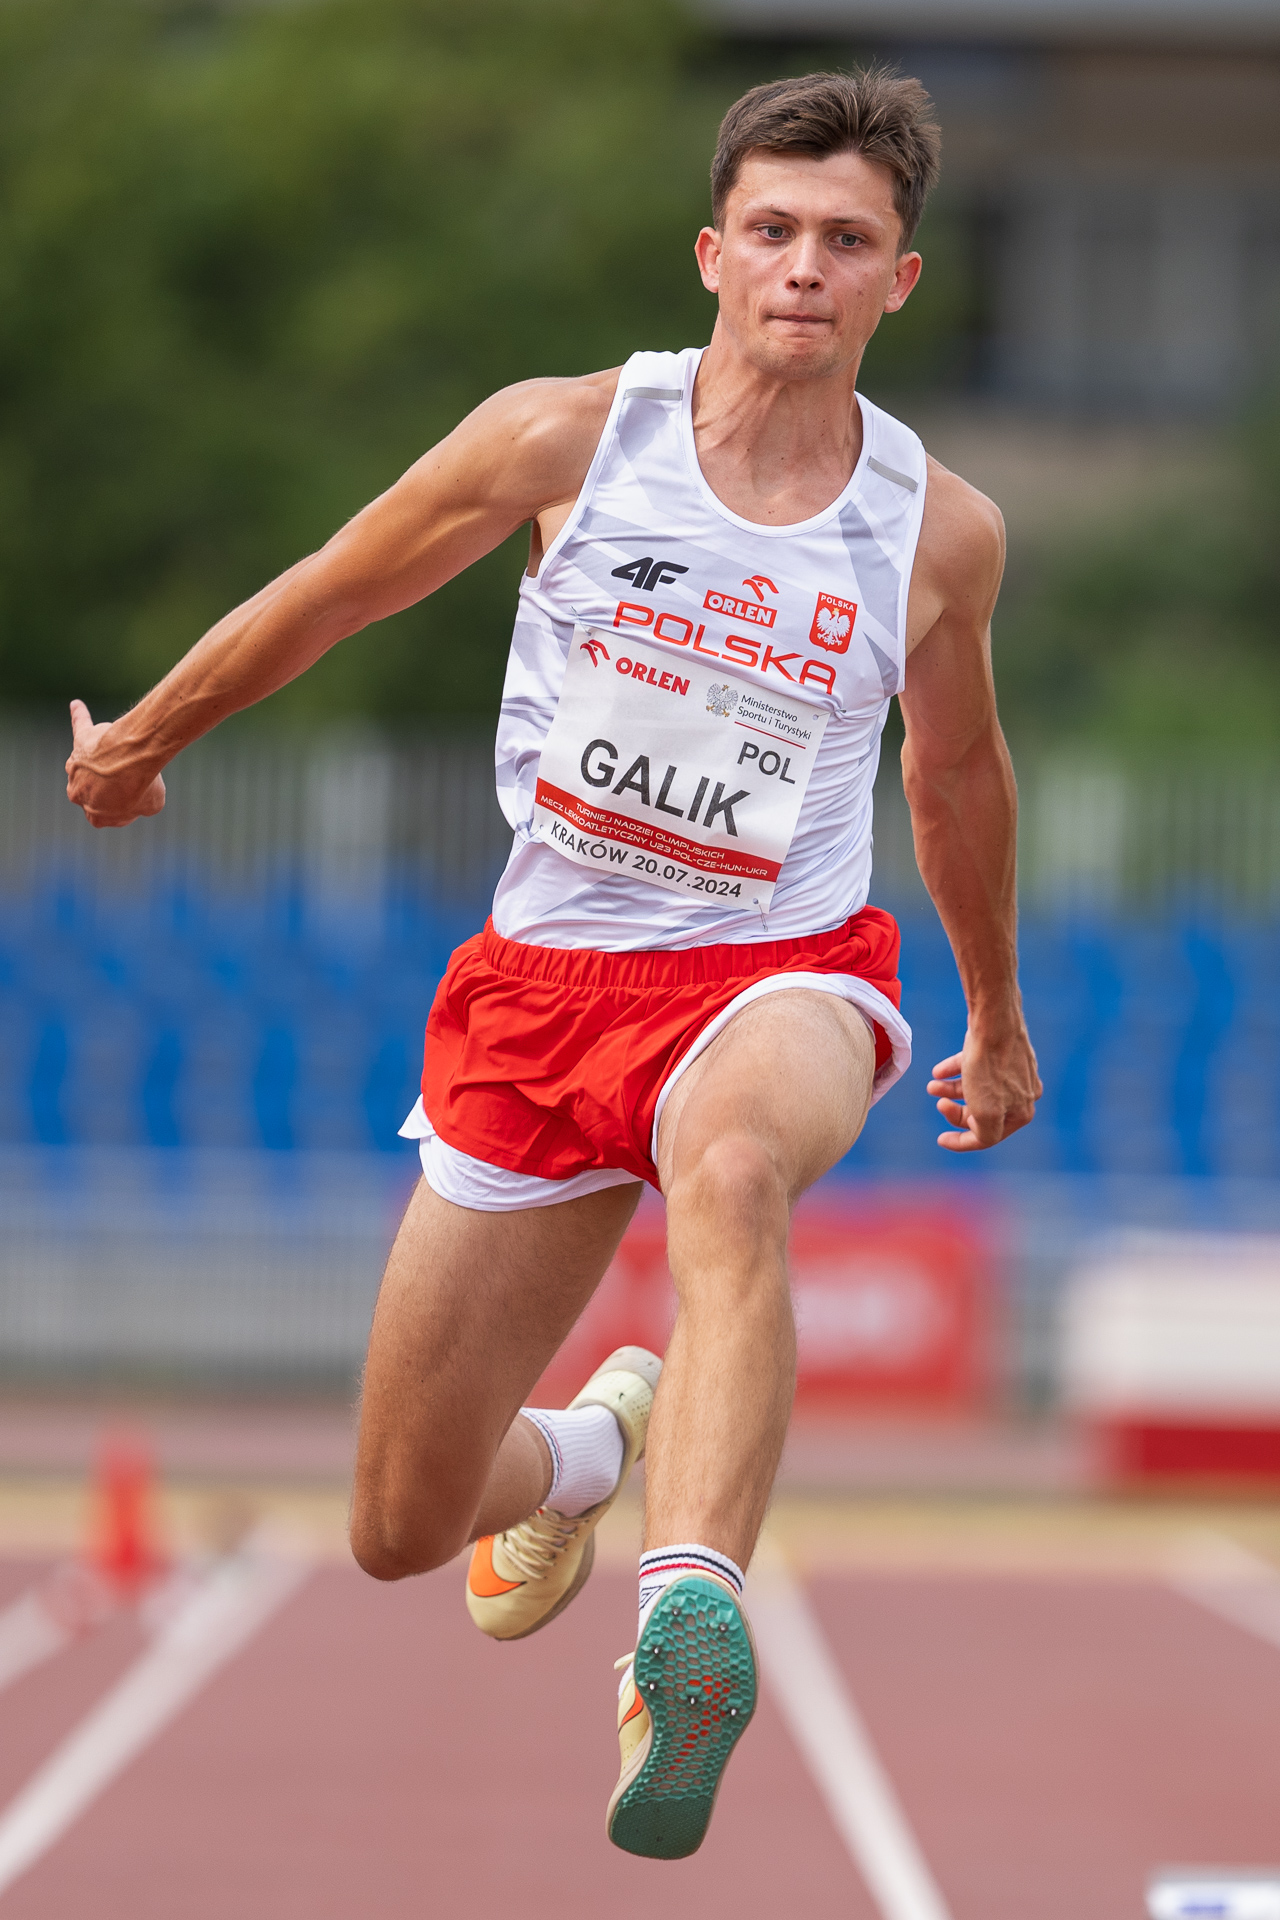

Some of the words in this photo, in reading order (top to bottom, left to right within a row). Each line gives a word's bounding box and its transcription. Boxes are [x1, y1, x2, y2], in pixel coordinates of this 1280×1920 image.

[611, 557, 689, 592] 4F
[708, 594, 772, 625] ORLEN
[820, 594, 855, 612] POLSKA
[613, 601, 836, 695] POLSKA
[615, 657, 690, 696] ORLEN
[737, 705, 767, 724] Sportu
[774, 718, 812, 741] Turystyki
[740, 694, 798, 722] Ministerstwo
[737, 741, 796, 785] POL
[580, 738, 751, 838] GALIK
[540, 795, 564, 812] MECZ
[564, 806, 648, 845] LEKKOATLETYCZNY
[649, 840, 671, 854] U23
[672, 849, 768, 876] POL-CZE-HUN-UKR
[576, 802, 613, 823] TURNIEJ
[614, 818, 654, 837] NADZIEI
[655, 832, 725, 860] OLIMPIJSKICH
[550, 820, 629, 864] KRAKÓW
[631, 855, 742, 898] 20.07.2024
